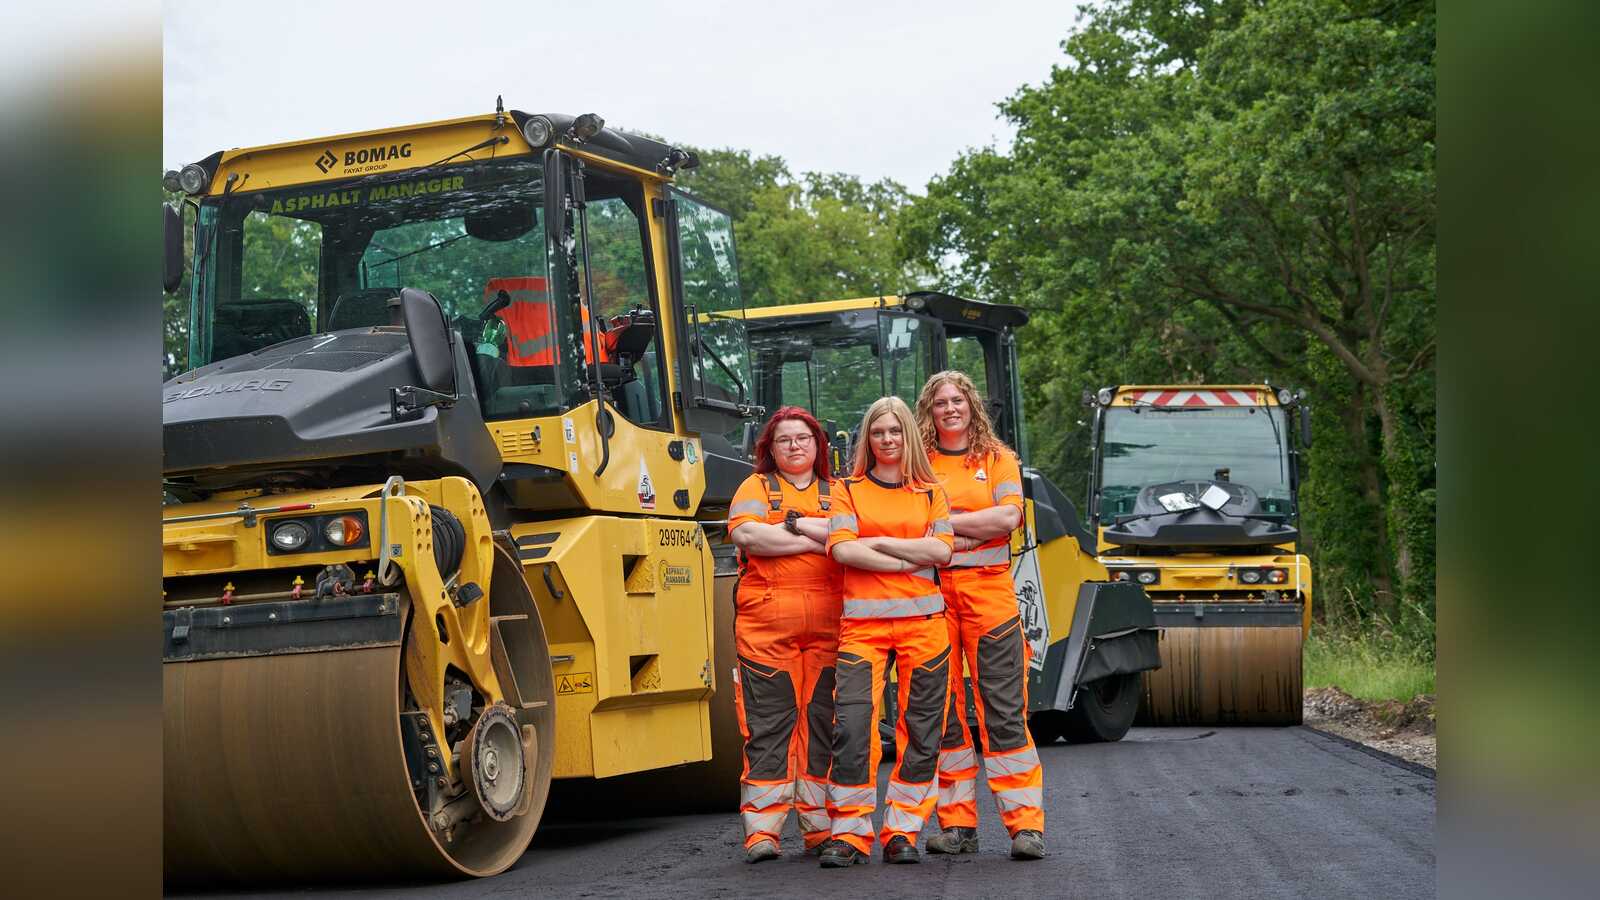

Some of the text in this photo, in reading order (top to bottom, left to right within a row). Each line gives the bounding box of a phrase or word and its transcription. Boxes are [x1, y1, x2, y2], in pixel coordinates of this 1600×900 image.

[344, 143, 411, 166] BOMAG
[343, 163, 388, 174] FAYAT GROUP
[270, 175, 465, 214] ASPHALT MANAGER
[659, 528, 691, 547] 299764
